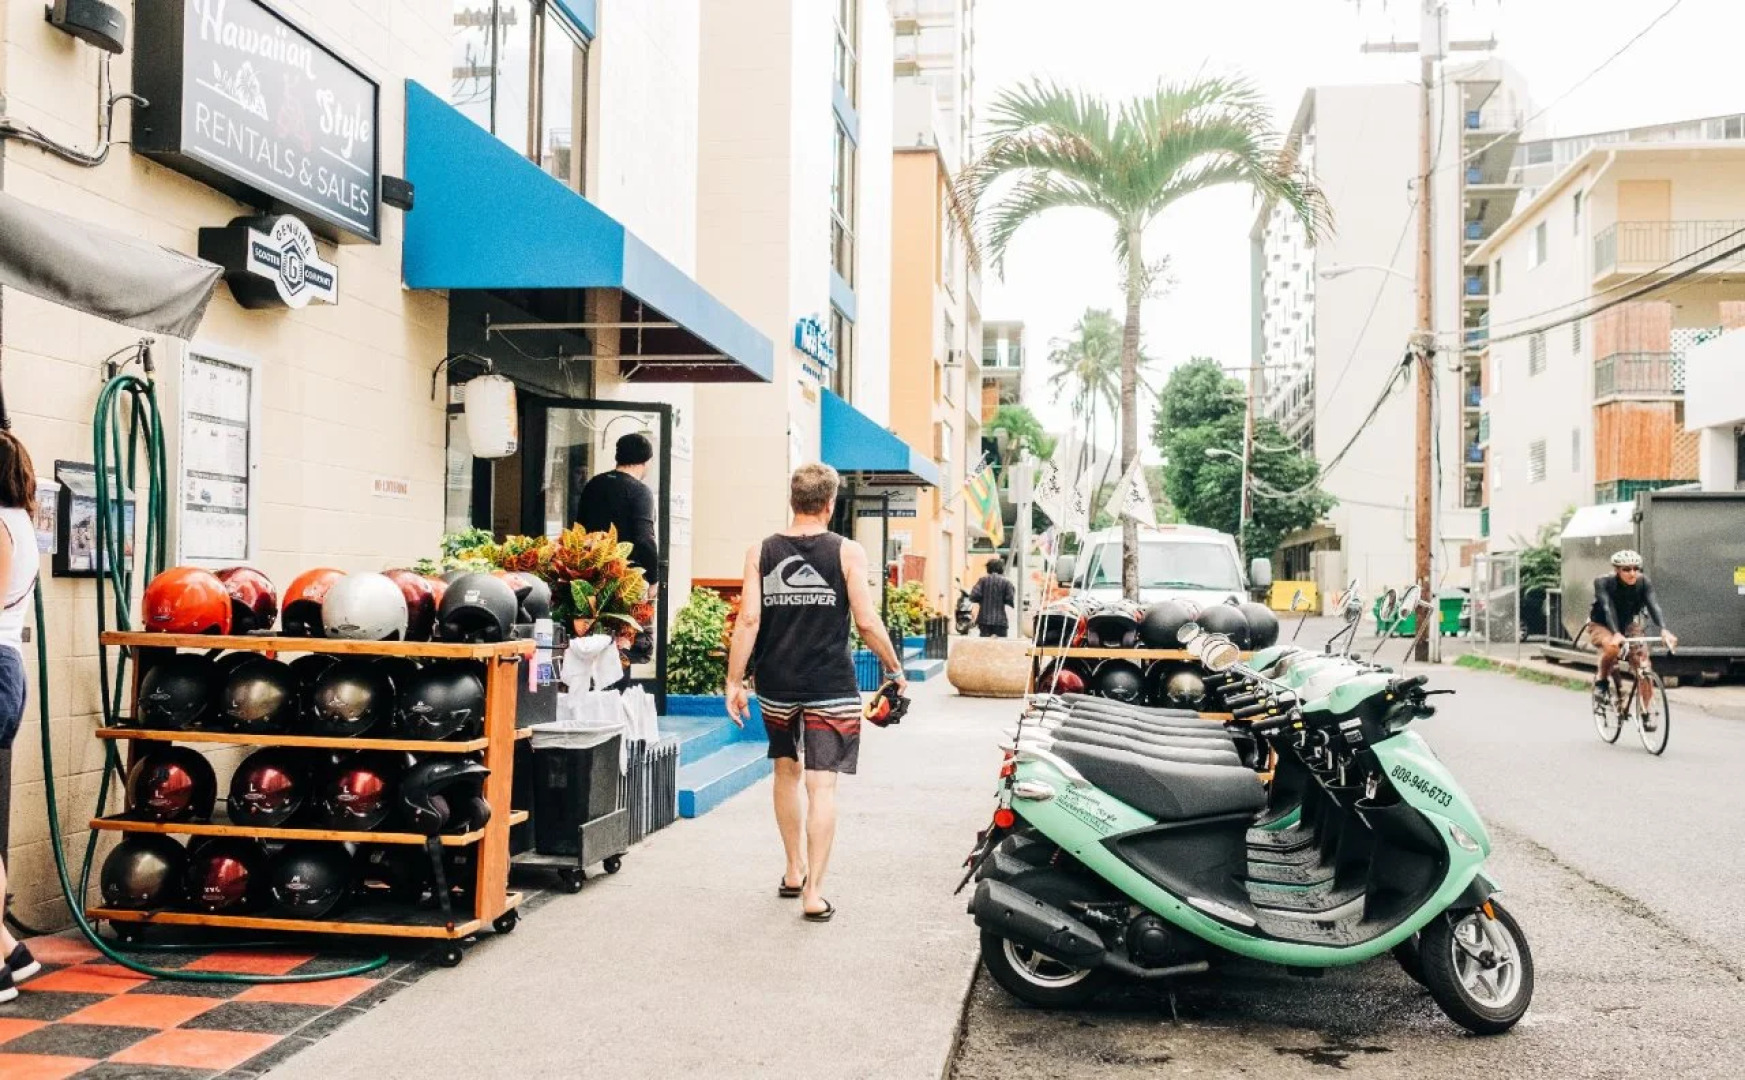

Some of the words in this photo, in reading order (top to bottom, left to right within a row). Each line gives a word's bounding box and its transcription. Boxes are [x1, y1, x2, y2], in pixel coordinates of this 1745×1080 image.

[192, 0, 317, 80] Hawaiian
[316, 88, 370, 159] Style
[195, 102, 295, 179] RENTALS
[299, 157, 313, 189] &
[317, 168, 369, 216] SALES
[276, 222, 311, 255] GENUINE
[288, 255, 298, 279] G
[763, 593, 837, 607] QUIKSILVER
[250, 783, 257, 792] L
[343, 785, 350, 793] L
[1391, 764, 1453, 807] 808-946-6733
